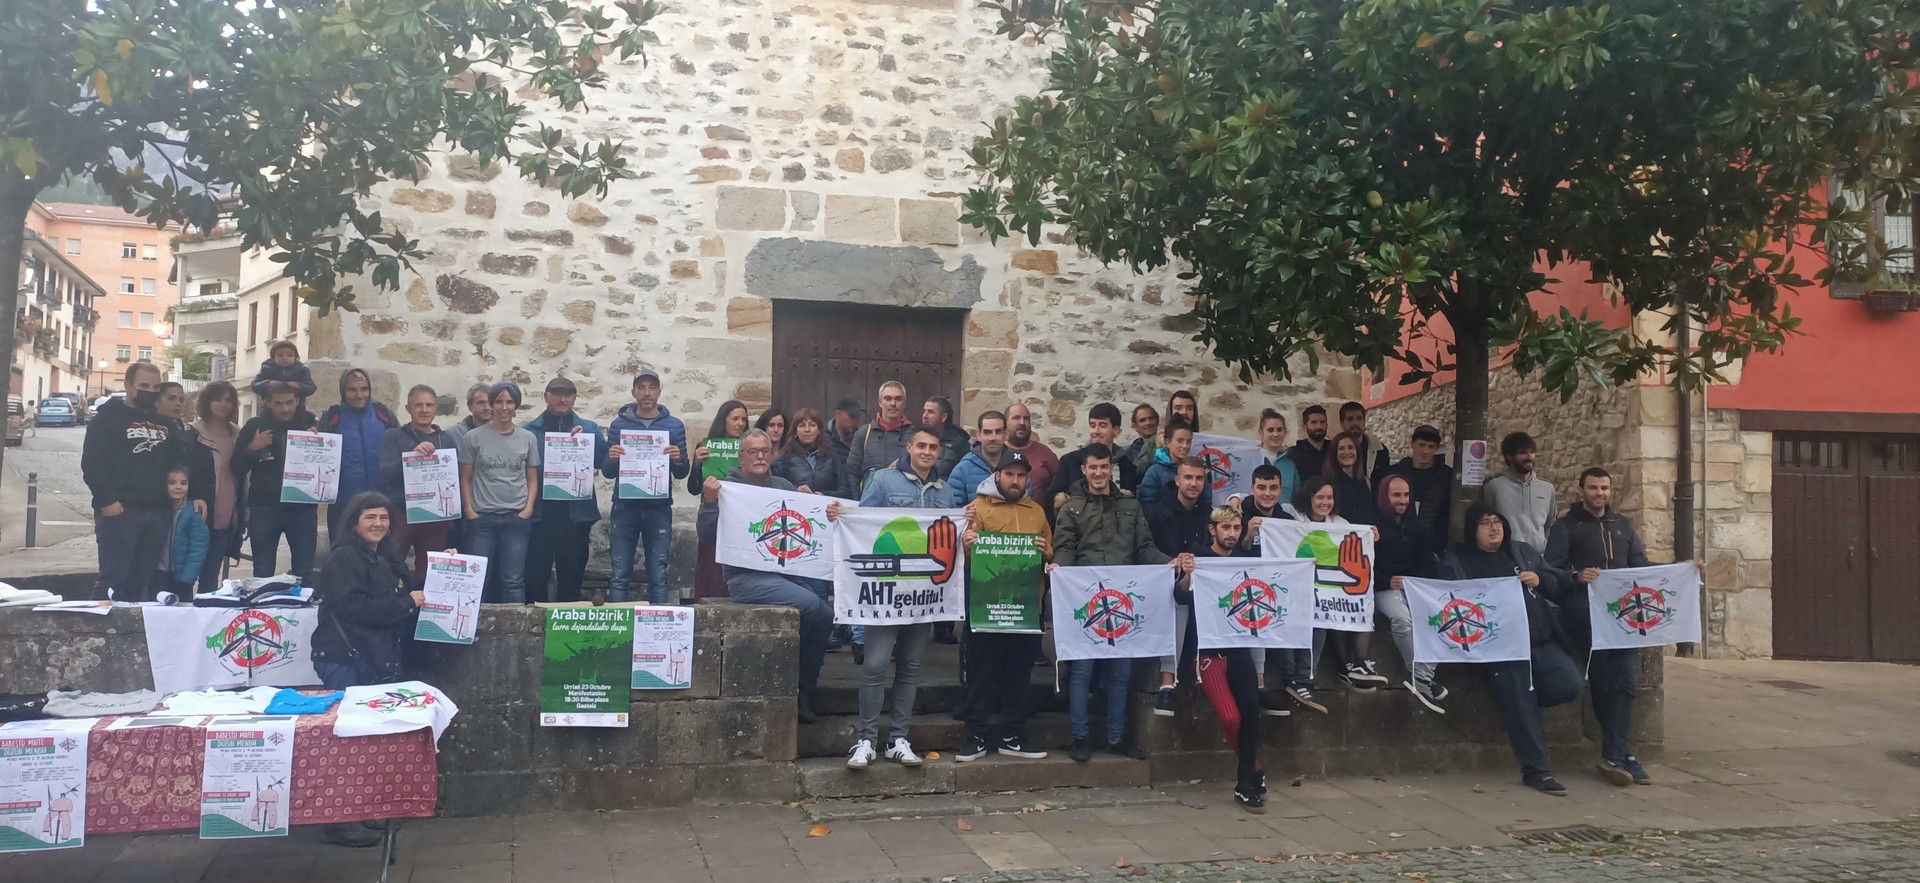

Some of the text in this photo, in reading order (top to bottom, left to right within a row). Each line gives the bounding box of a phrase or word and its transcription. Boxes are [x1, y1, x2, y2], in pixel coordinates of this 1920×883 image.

[706, 440, 733, 450] Araba
[976, 534, 1034, 546] Araba bizirik
[858, 581, 944, 609] AHT gelditu!
[847, 605, 945, 619] ELKARLANA
[1320, 597, 1365, 613] gelditu!
[231, 611, 271, 629] MENETAN
[551, 607, 630, 622] Araba bizirik !
[1314, 612, 1367, 624] ARLANA
[552, 621, 628, 635] lurra defendatuko dugu
[27, 739, 45, 747] MAITE
